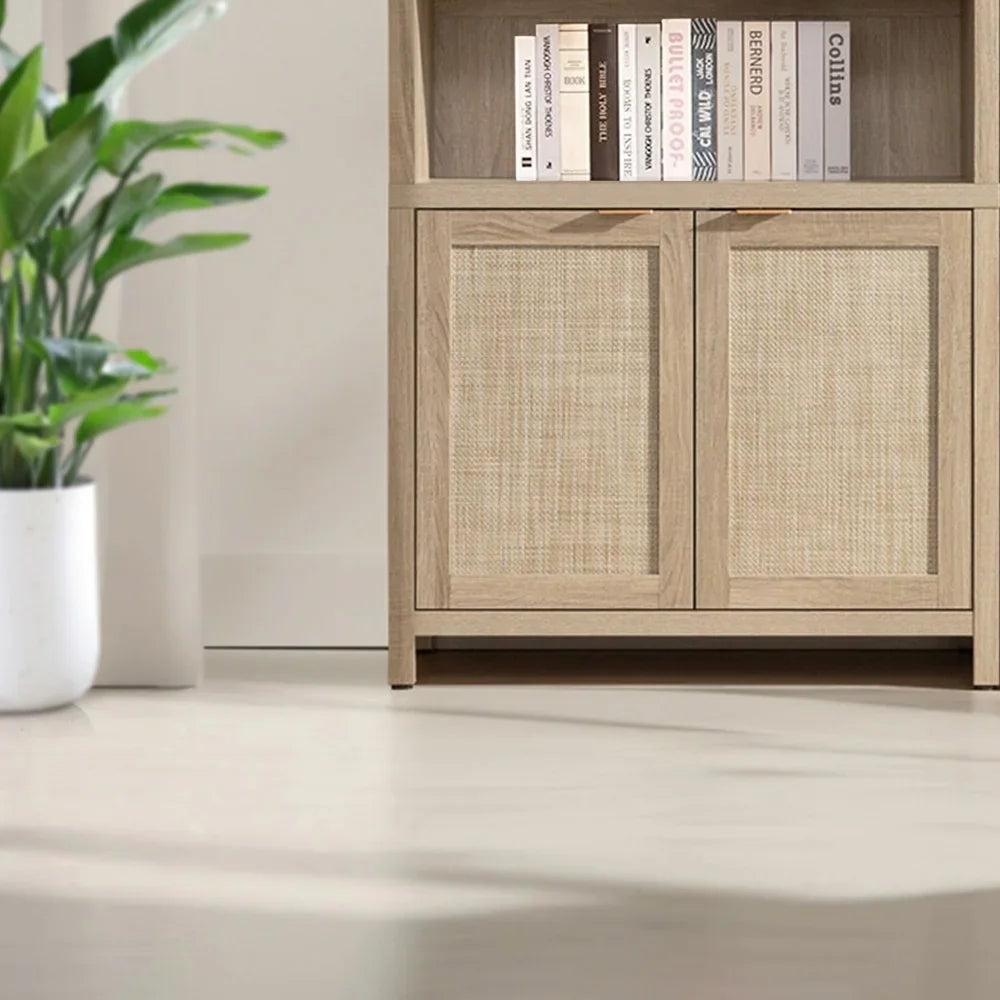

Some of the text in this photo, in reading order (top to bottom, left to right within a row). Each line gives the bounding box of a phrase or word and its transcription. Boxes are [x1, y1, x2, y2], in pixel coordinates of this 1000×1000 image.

[524, 59, 532, 78] TIAN
[543, 35, 551, 71] VANGOGH
[696, 58, 704, 79] JACK
[705, 52, 713, 85] LONDON
[749, 30, 763, 95] BERNERD
[828, 33, 845, 106] Collins
[524, 81, 532, 98] LAN
[564, 76, 586, 85] BOOK
[668, 32, 685, 162] BULLET PROOF
[524, 101, 532, 125] DONG
[599, 61, 608, 143] THE HOLY BIBLE
[697, 90, 713, 122] WILD
[524, 128, 532, 151] SHAN
[623, 79, 632, 177] ROOMS TO INSPIRE
[644, 135, 652, 171] VANGOGH
